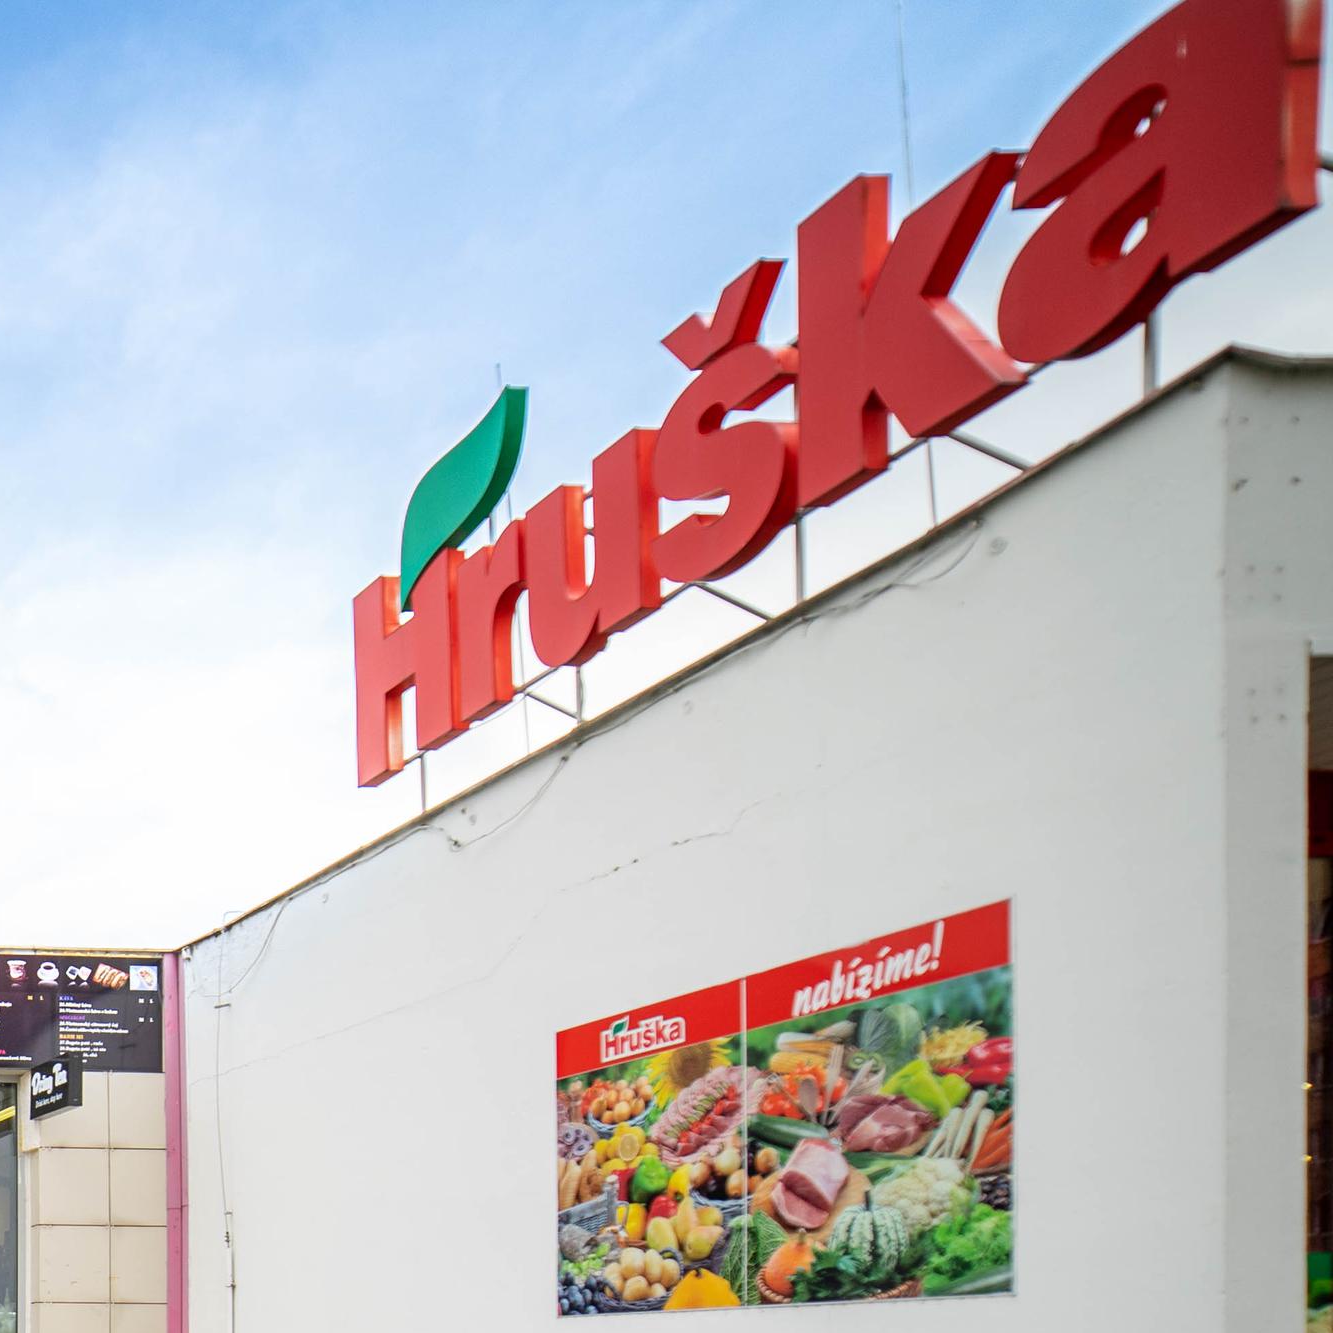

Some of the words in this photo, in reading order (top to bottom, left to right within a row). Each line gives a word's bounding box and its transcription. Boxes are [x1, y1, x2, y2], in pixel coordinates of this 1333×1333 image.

[353, 0, 1325, 788] Hruška
[792, 920, 945, 1017] nabízíme!
[604, 1021, 680, 1058] Hruška
